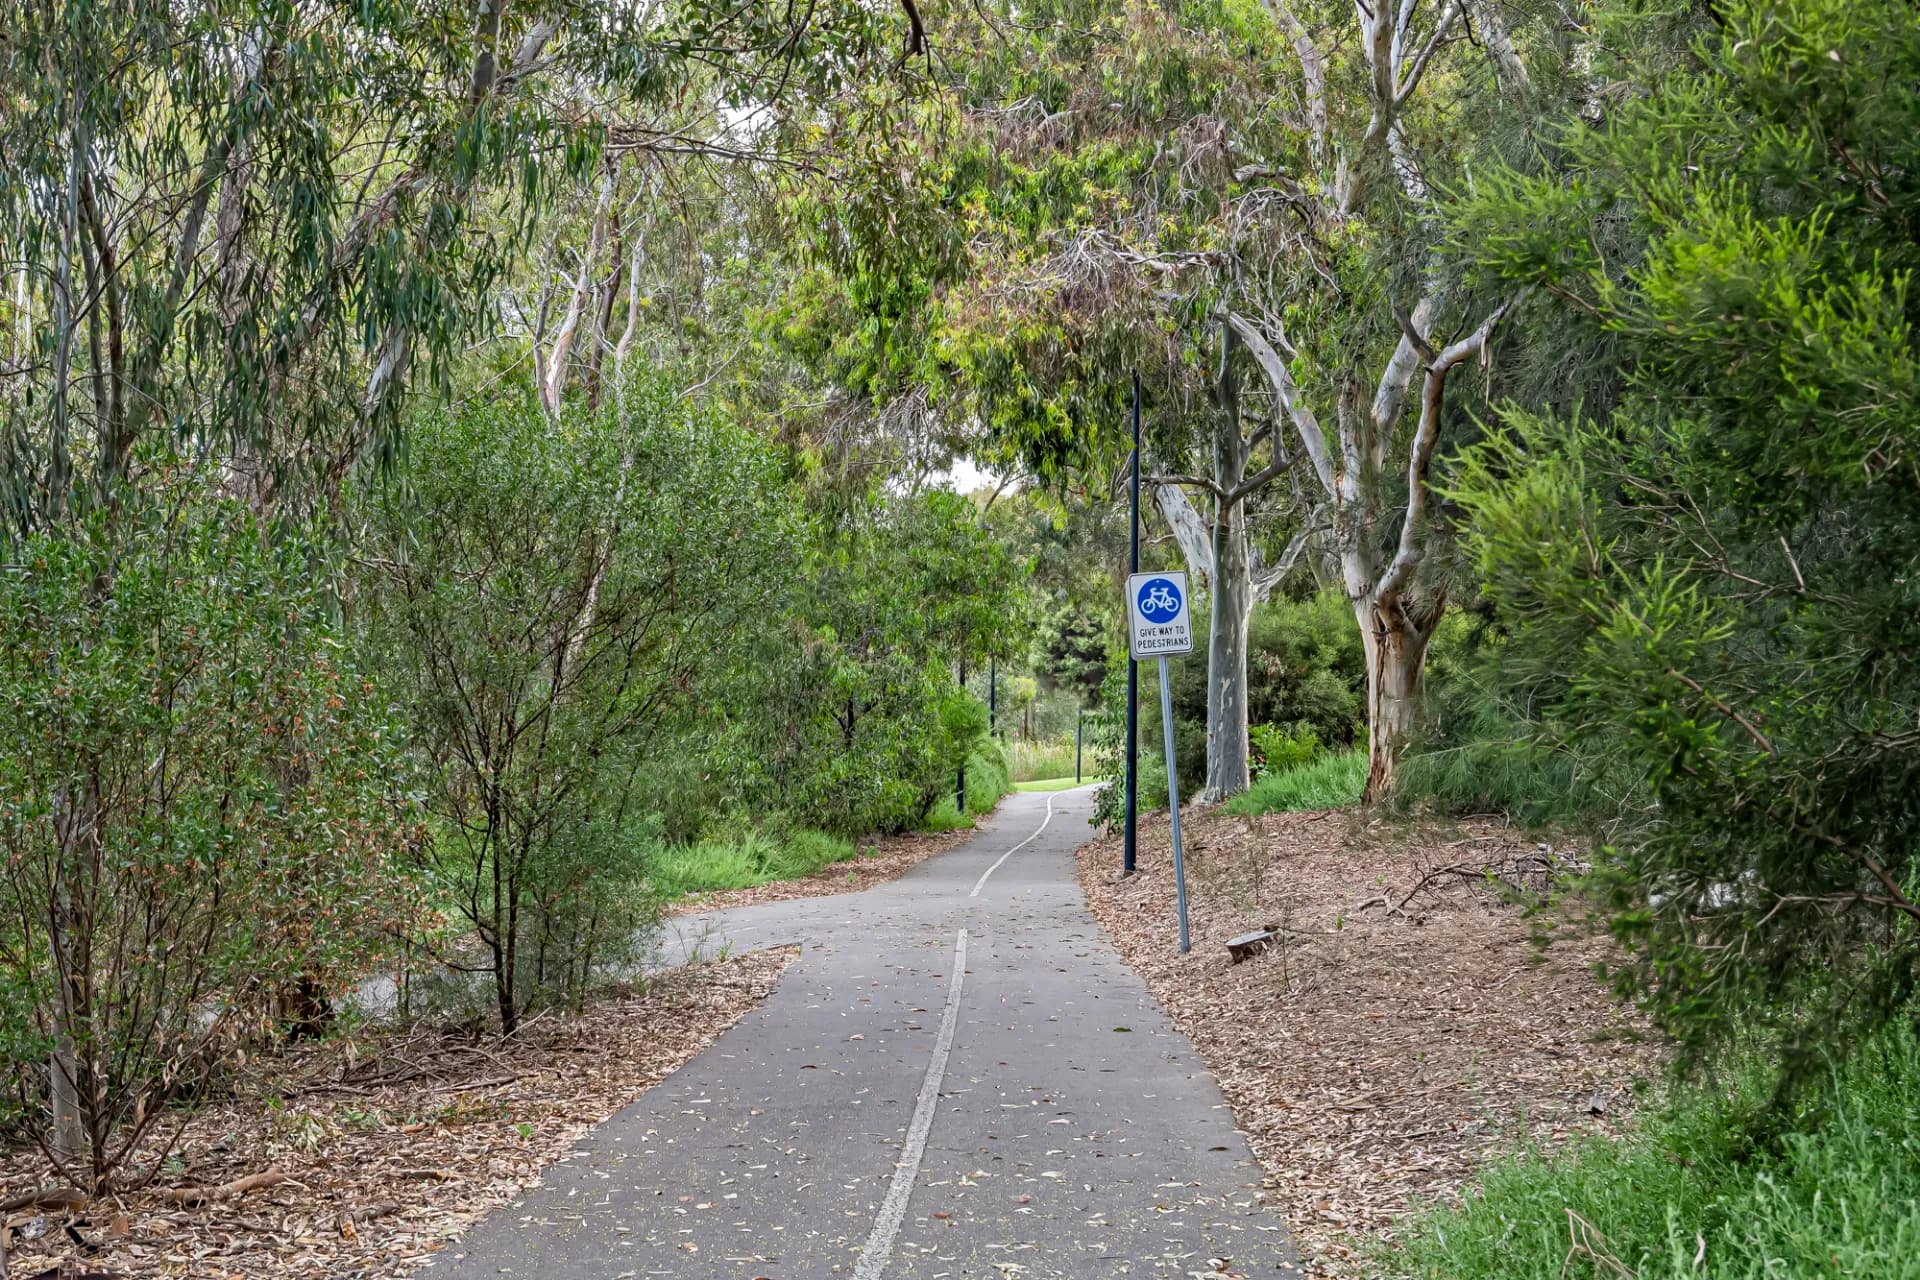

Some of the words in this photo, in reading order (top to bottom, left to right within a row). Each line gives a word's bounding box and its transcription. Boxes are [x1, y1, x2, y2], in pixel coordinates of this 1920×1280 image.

[1140, 628, 1157, 637] GIVE
[1159, 626, 1173, 635] WAY
[1176, 625, 1185, 634] TO
[1138, 637, 1189, 648] PEDESTRIANS
